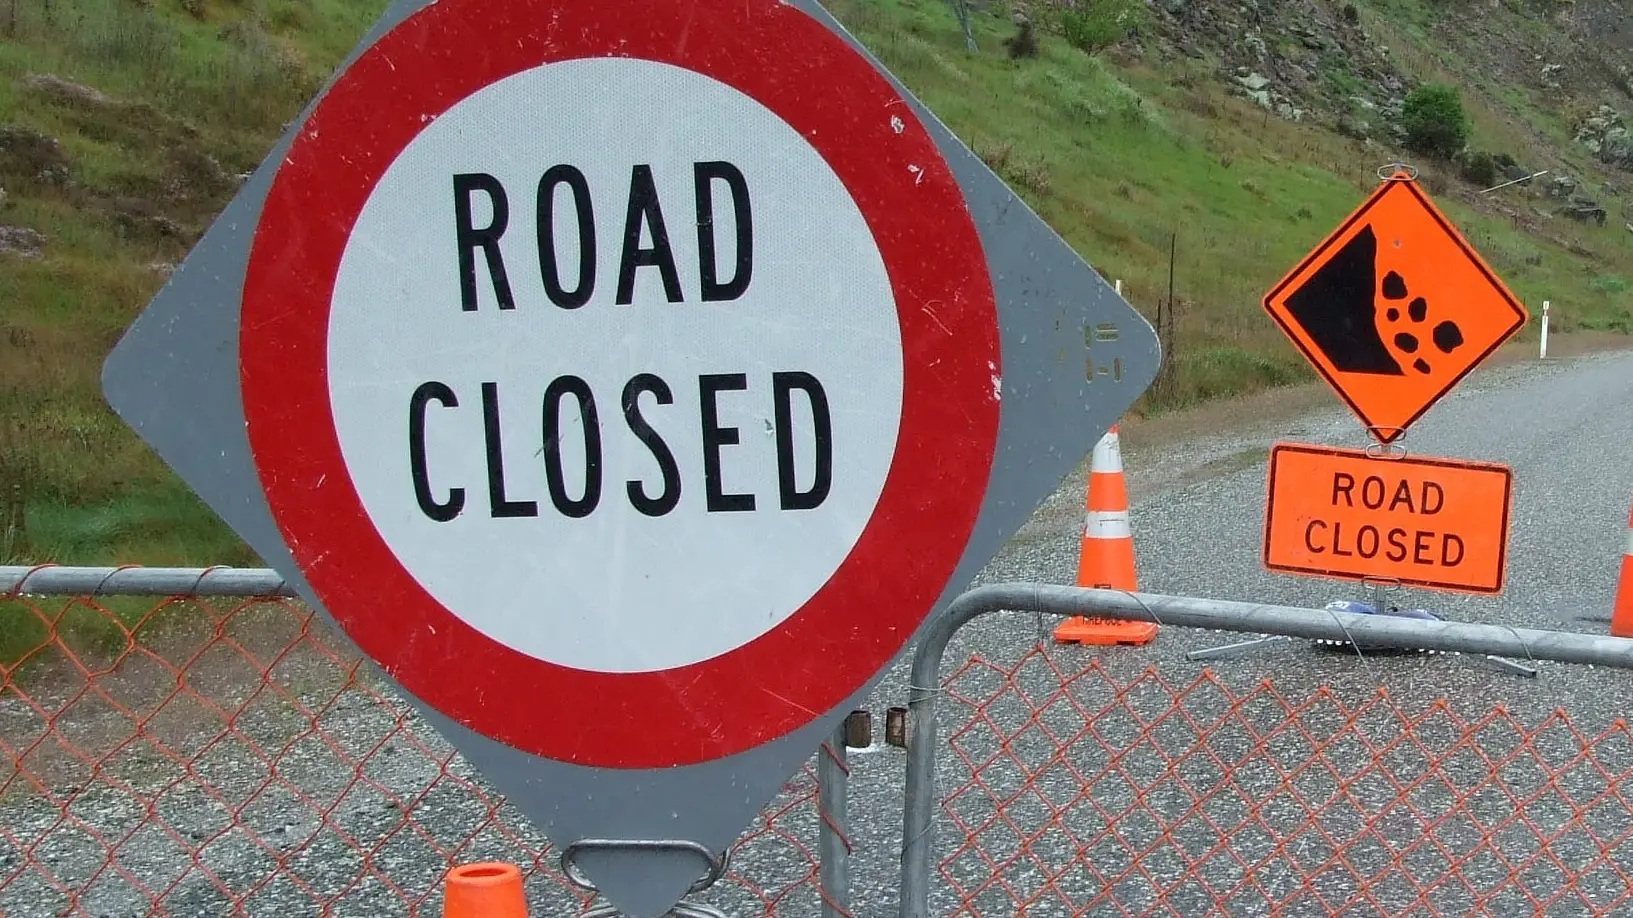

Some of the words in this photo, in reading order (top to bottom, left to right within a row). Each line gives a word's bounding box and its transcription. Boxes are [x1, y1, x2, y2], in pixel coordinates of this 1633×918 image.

[453, 161, 753, 311] ROAD
[409, 371, 833, 523] CLOSED
[1332, 472, 1445, 516] ROAD
[1304, 519, 1465, 568] CLOSED
